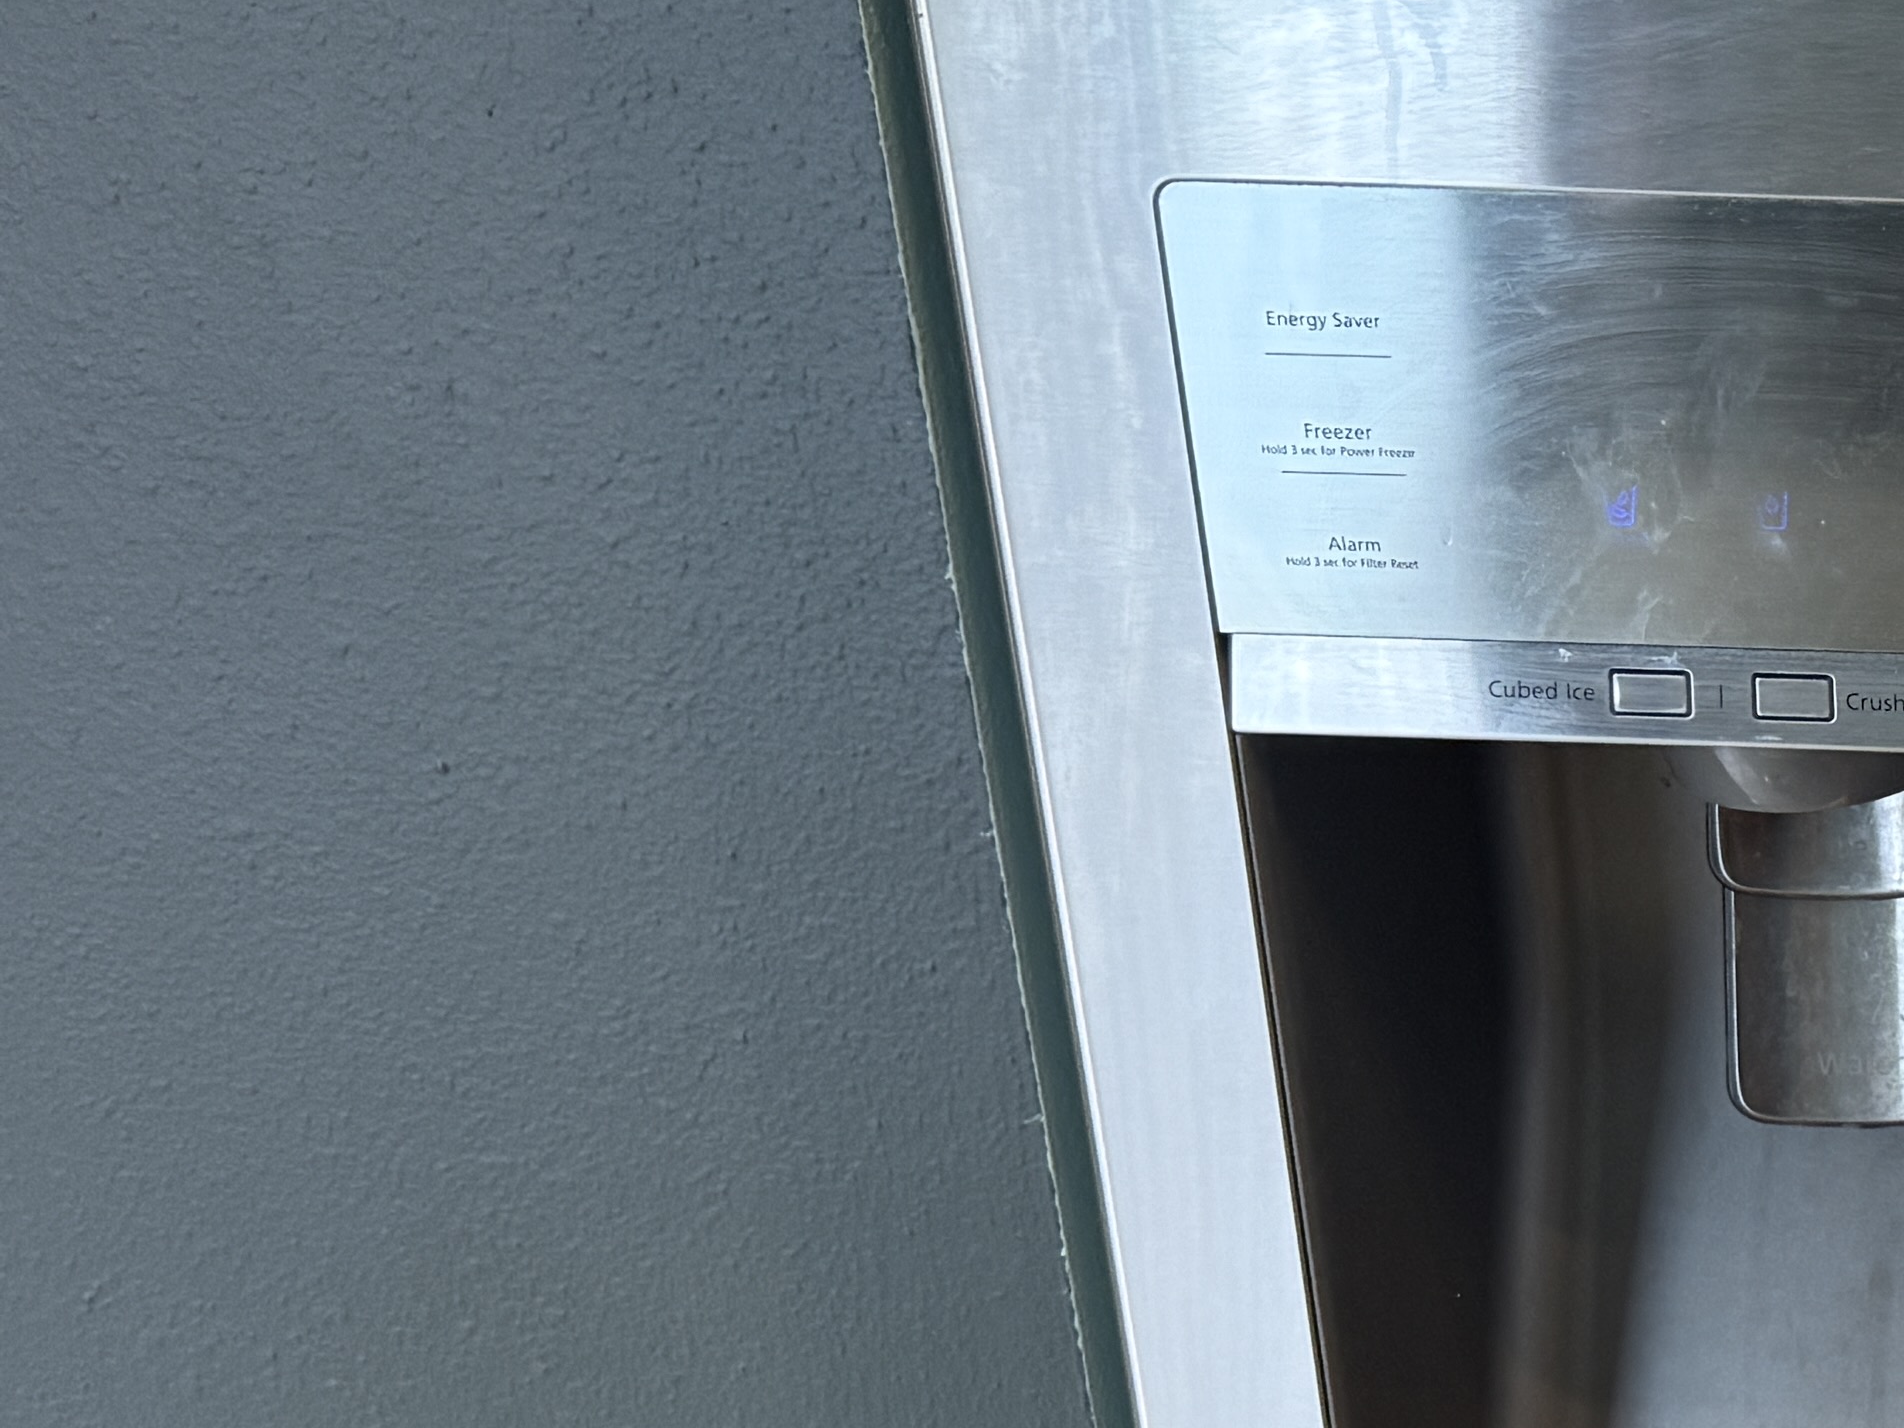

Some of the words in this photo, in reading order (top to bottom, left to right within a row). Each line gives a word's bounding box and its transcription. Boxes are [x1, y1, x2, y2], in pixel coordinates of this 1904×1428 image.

[1265, 309, 1328, 332] Energy
[1333, 311, 1381, 329] Saver
[1303, 423, 1373, 440] Freezer
[1261, 444, 1288, 455] Hold
[1291, 444, 1298, 455] 3
[1320, 445, 1336, 456] for
[1340, 446, 1375, 457] Power
[1328, 536, 1382, 552] Alarm
[1286, 556, 1311, 566] Hold
[1342, 556, 1357, 567] for
[1487, 679, 1559, 701] Cubed
[1565, 681, 1596, 703] Ice
